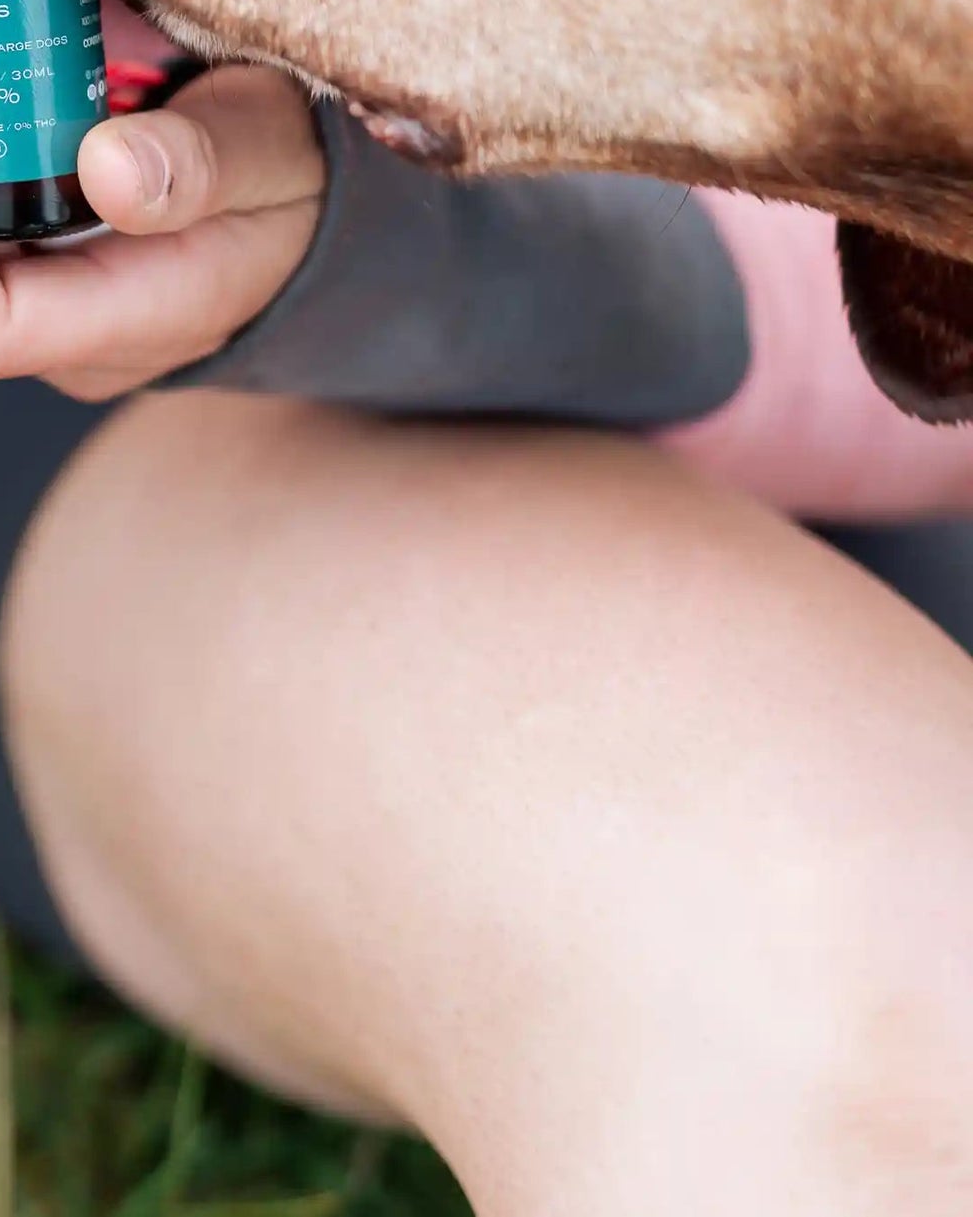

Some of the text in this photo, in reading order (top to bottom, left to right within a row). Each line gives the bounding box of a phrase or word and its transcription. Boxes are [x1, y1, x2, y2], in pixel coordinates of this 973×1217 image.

[36, 35, 68, 49] DOGS
[11, 67, 55, 81] 30ML
[14, 121, 32, 131] 0%
[34, 118, 57, 129] THC
